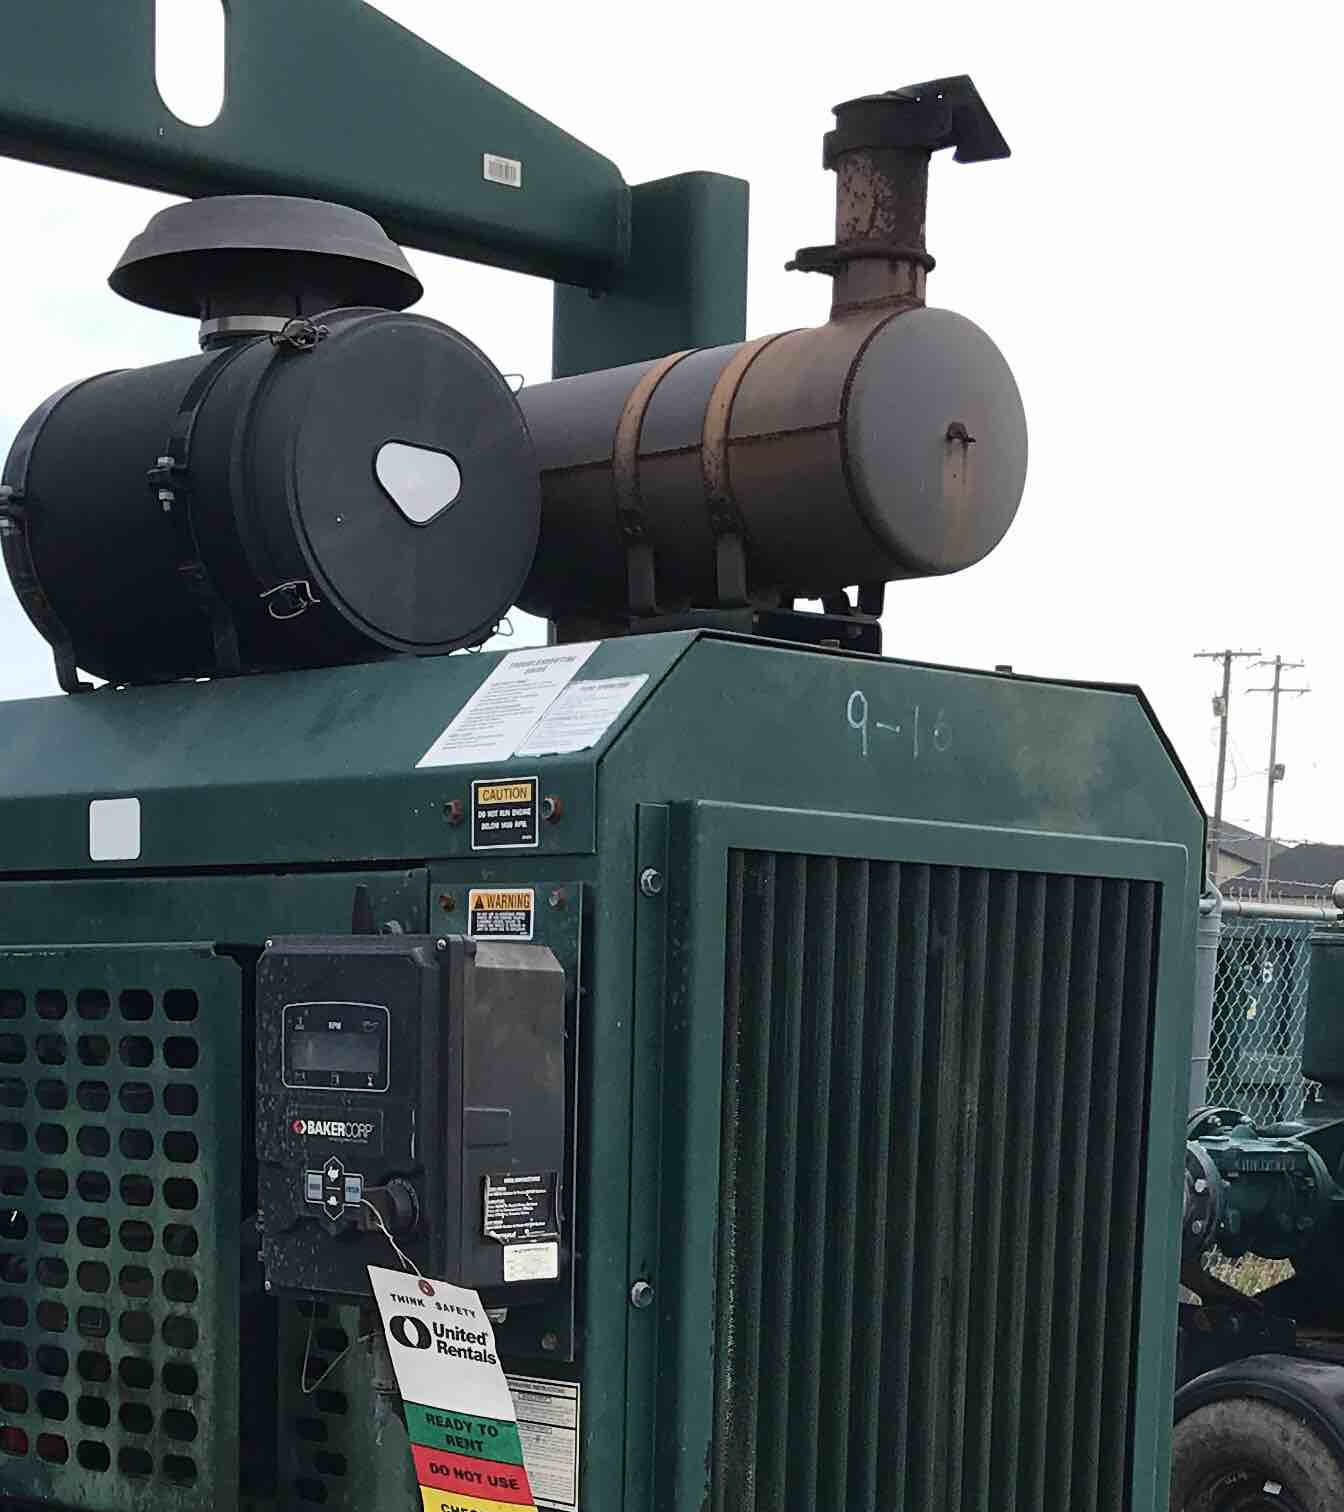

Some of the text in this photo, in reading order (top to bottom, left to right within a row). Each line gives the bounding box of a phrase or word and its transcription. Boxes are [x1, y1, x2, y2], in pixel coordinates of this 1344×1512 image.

[482, 787, 527, 801] CAUTION
[487, 893, 530, 909] WARNING
[390, 1293, 477, 1319] THINK SAFETY
[432, 1321, 488, 1347] United
[436, 1339, 497, 1366] Rentals
[425, 1412, 499, 1438] READY TO
[445, 1433, 484, 1453] RENT
[429, 1462, 519, 1491] DO NOT USE
